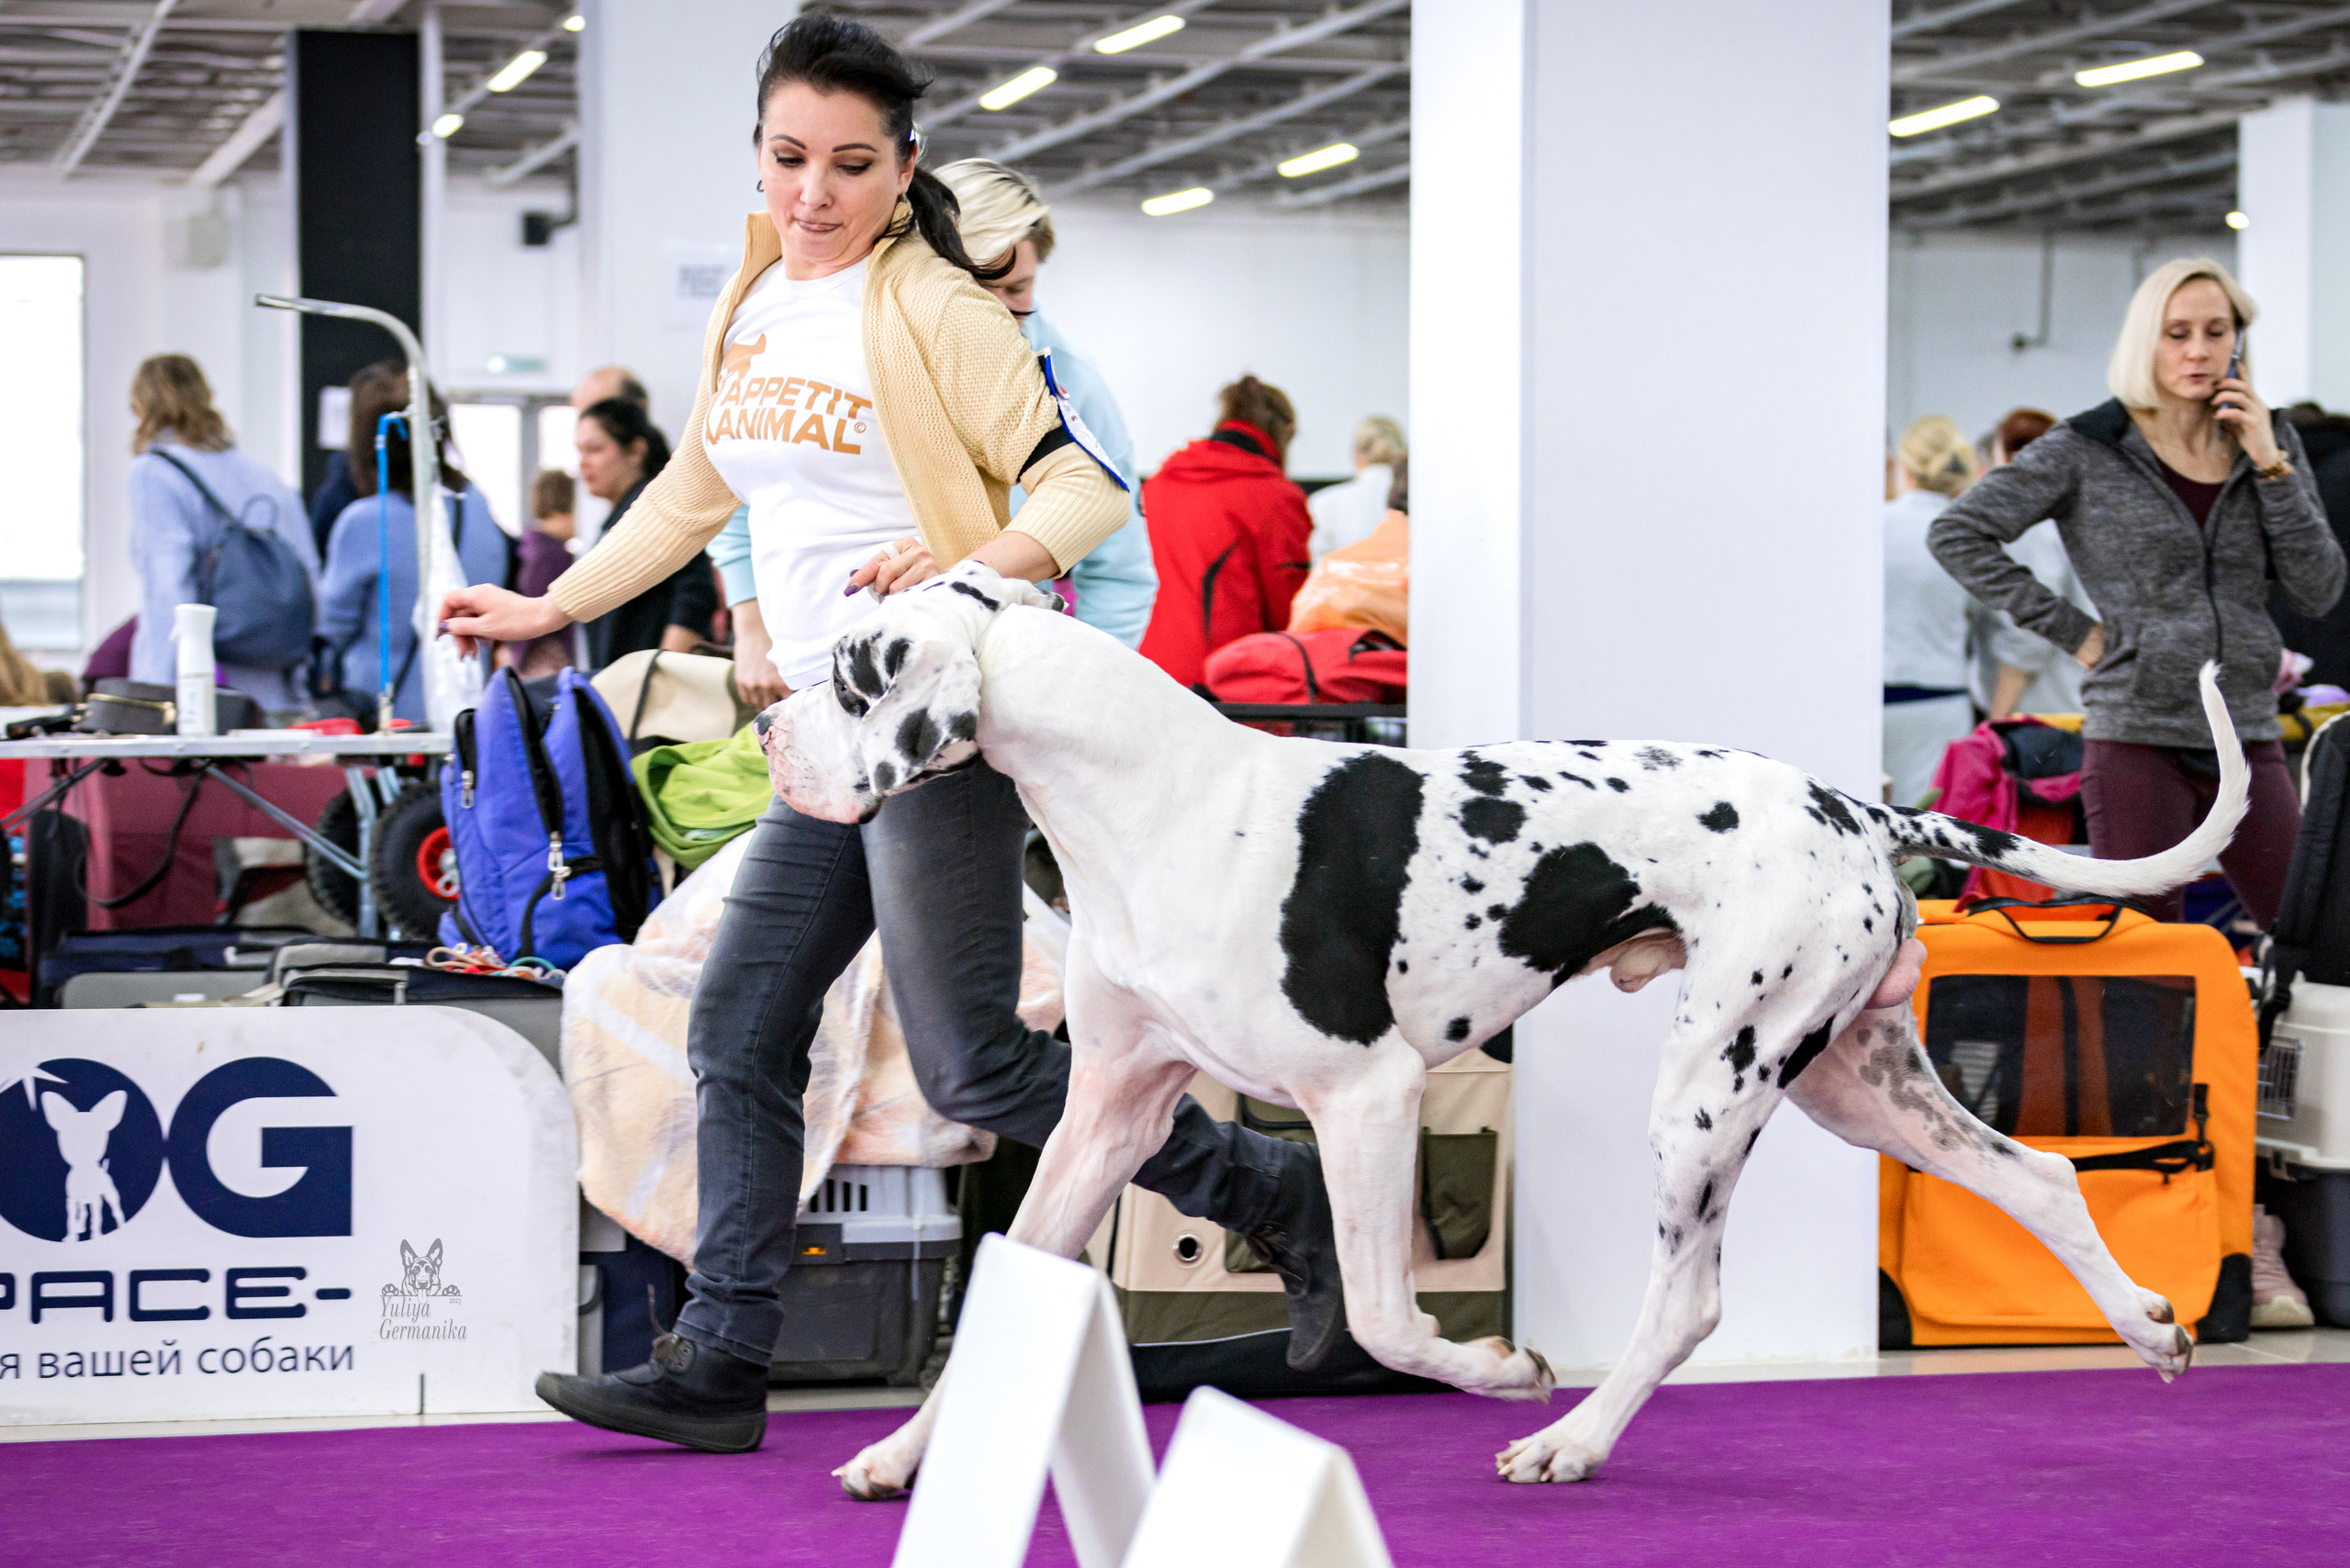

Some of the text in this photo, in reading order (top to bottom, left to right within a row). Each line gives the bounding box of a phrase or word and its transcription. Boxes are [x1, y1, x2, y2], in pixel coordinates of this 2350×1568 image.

[720, 376, 873, 420] APPETIT
[0, 1266, 352, 1325] ACE-
[38, 1338, 183, 1379] вашей
[196, 1335, 353, 1375] собаки
